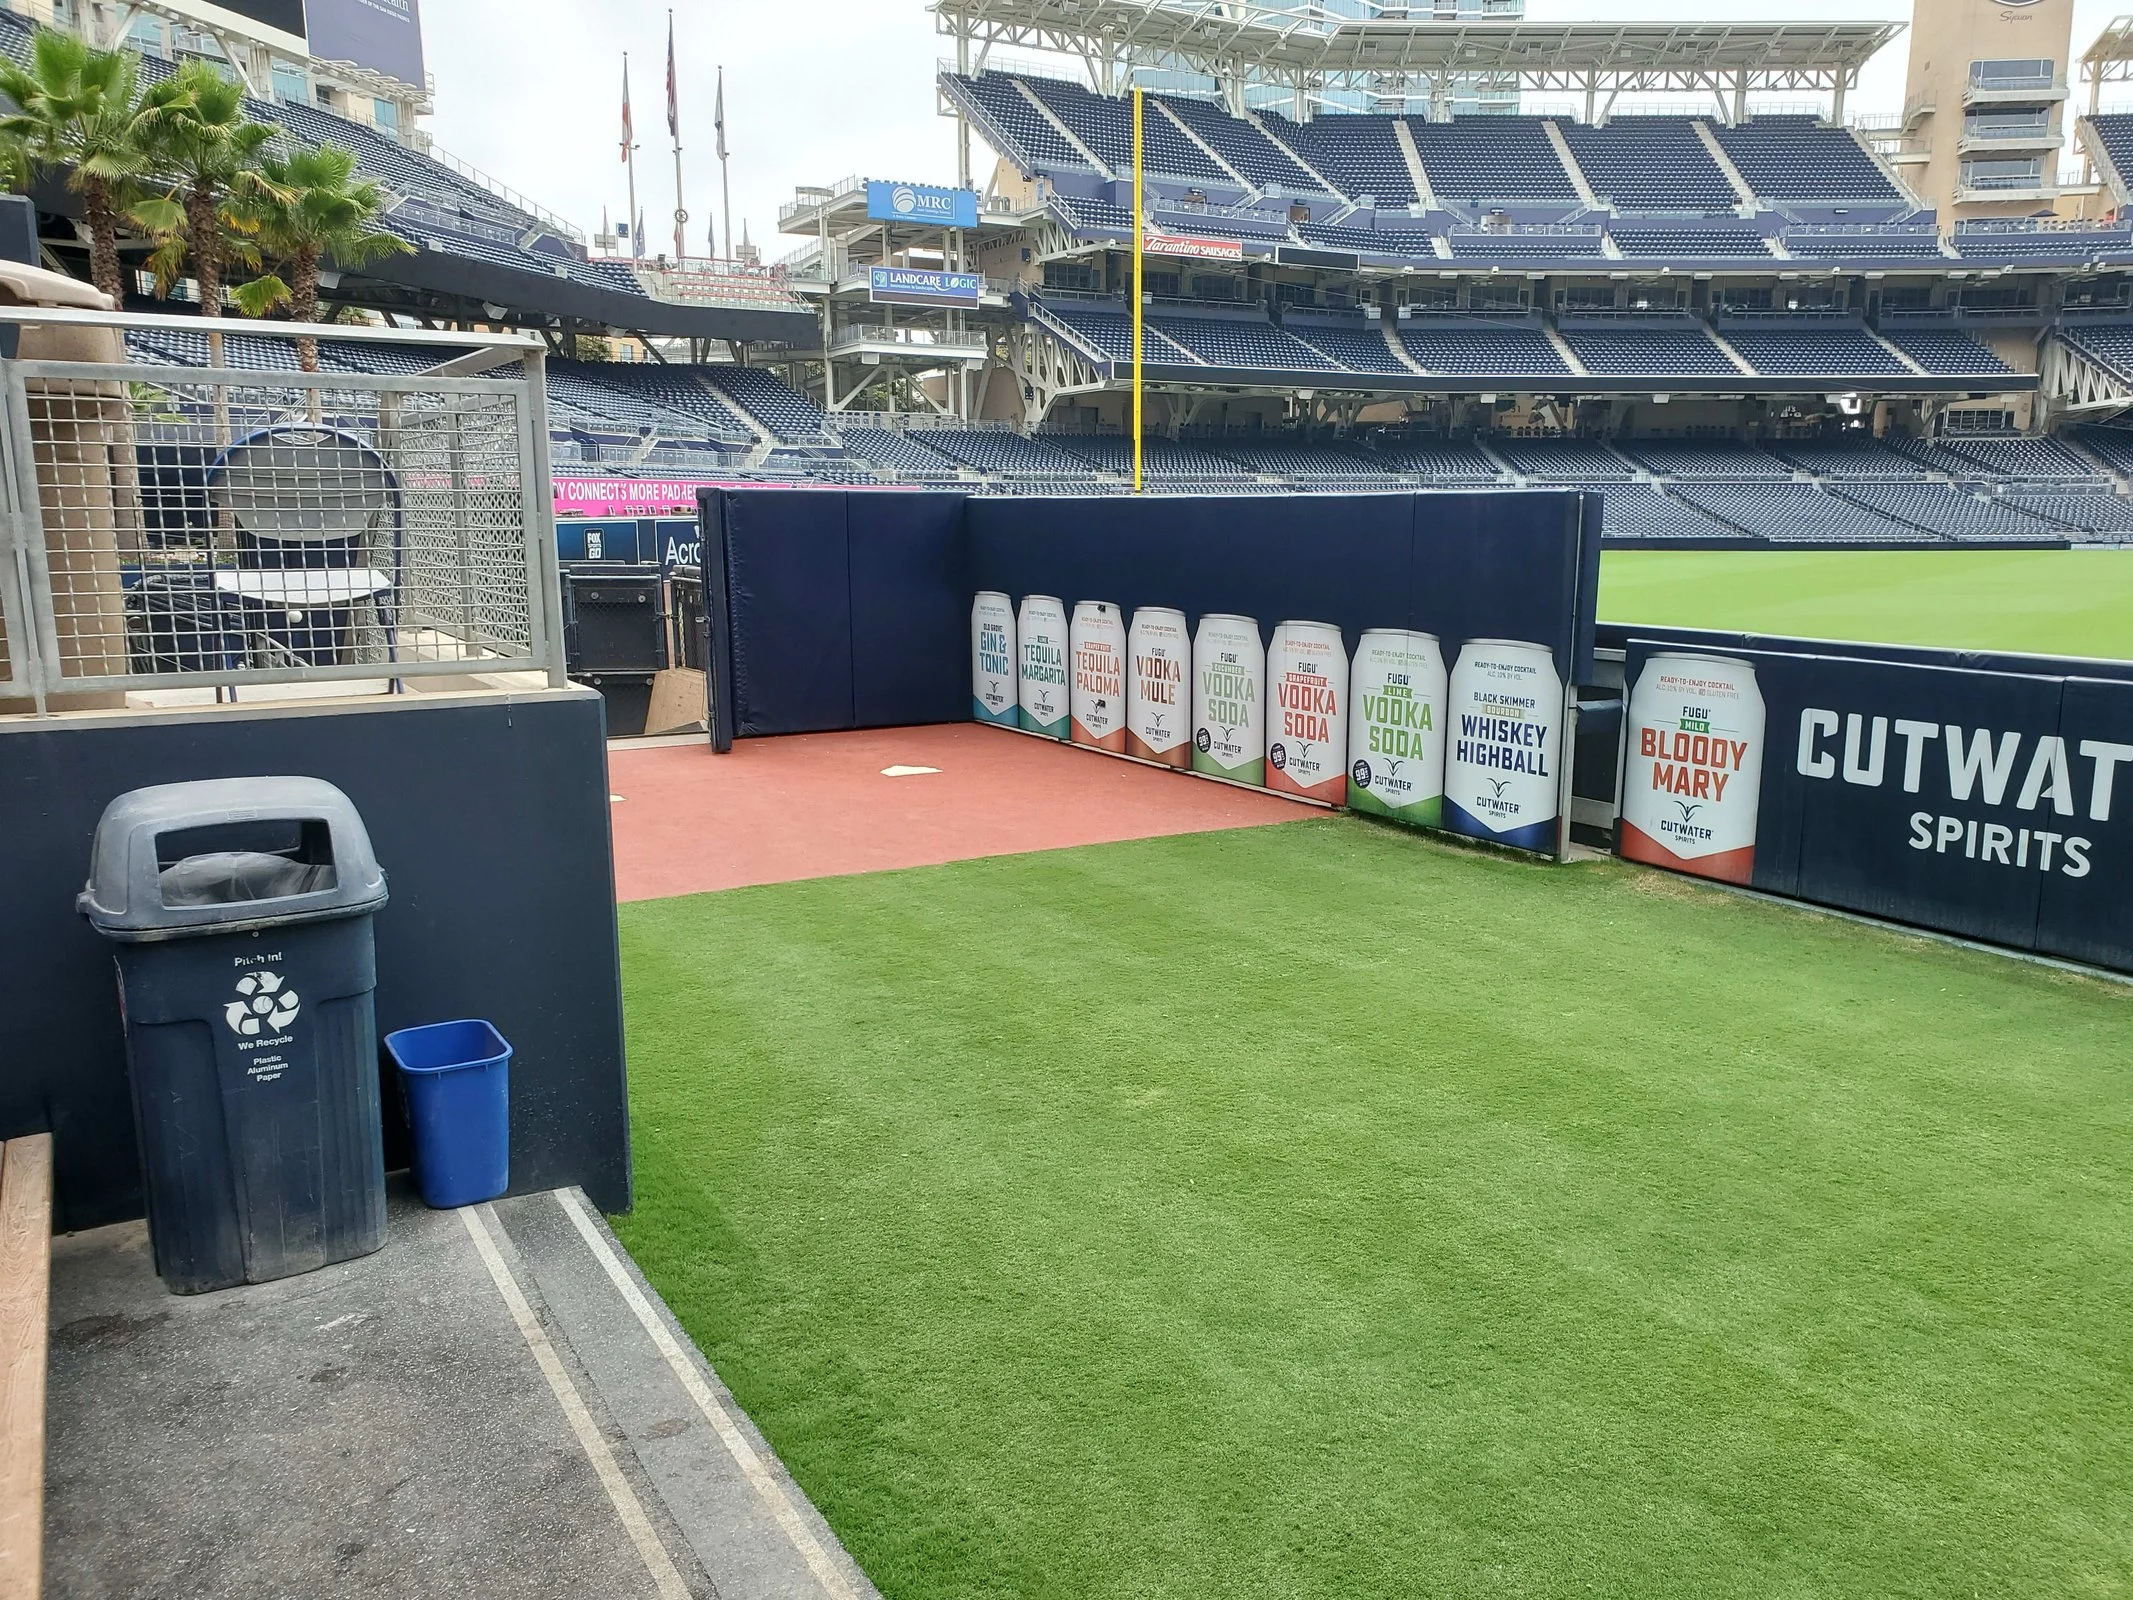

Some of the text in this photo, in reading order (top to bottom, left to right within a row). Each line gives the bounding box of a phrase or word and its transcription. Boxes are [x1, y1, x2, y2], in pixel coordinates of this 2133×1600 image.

[917, 194, 951, 210] MRC
[1145, 236, 1240, 258] Tarantino SAUSAGES
[890, 272, 942, 287] LANDCARE
[630, 484, 659, 500] MORE
[587, 532, 600, 543] FOX
[588, 548, 601, 559] GO
[980, 632, 1007, 654] GIN &
[1024, 644, 1062, 666] TEQUILA
[1152, 648, 1164, 657] FUGU
[1221, 652, 1236, 663] FUGU
[980, 652, 1009, 676] TONIC
[1076, 651, 1120, 676] TEQUILA
[1136, 655, 1180, 682] VODKA
[1215, 664, 1242, 673] CUCUMBER
[1298, 662, 1316, 673] FUGU
[1514, 666, 1536, 674] COCKTAIL
[1021, 664, 1066, 686] MARGARITA
[1289, 674, 1324, 686] GRAPEFRUIT
[1387, 673, 1408, 686] FUGU
[1076, 672, 1120, 697] PALOMA
[1203, 672, 1255, 702] VODKA
[1388, 687, 1408, 697] LIME
[1708, 681, 1735, 690] COCKTAIL
[986, 693, 1004, 703] CUTWATER
[1140, 680, 1175, 705] MULE
[1278, 683, 1337, 716] VODKA
[1034, 702, 1054, 713] CUTWATER
[1474, 692, 1535, 709] BLACK SKIMMER
[1208, 698, 1249, 728] SODA
[1363, 694, 1432, 732] VODKA
[1487, 706, 1520, 717] BOURBON
[1682, 707, 1708, 719] FUGU
[1086, 714, 1108, 725] CUTWATER
[1685, 720, 1705, 732] MILD
[1146, 727, 1170, 738] CUTWATER
[1284, 712, 1329, 743] SODA
[1461, 714, 1548, 748] WHISKEY
[1213, 741, 1242, 754] CUTWATER
[1369, 725, 1423, 761] SODA
[1640, 727, 1748, 771] BLOODY
[1289, 757, 1320, 771] CUTWATER
[1456, 740, 1548, 777] HIGHBALL
[1797, 707, 2133, 822] CUTWAT
[1355, 768, 1366, 781] 99
[1652, 762, 1729, 802] MARY
[1375, 775, 1411, 791] CUTWATER
[1476, 797, 1519, 814] CUTWATER
[1489, 810, 1506, 818] SPIRITS
[1661, 820, 1712, 840] CUTWATER
[1675, 835, 1696, 845] SPIRITS
[1908, 812, 2092, 878] SPIRITS
[268, 951, 282, 962] In!
[238, 1035, 293, 1050] We Recycle
[253, 1055, 282, 1065] Plastic
[247, 1062, 288, 1075] Aluminum
[257, 1072, 282, 1082] Paper
